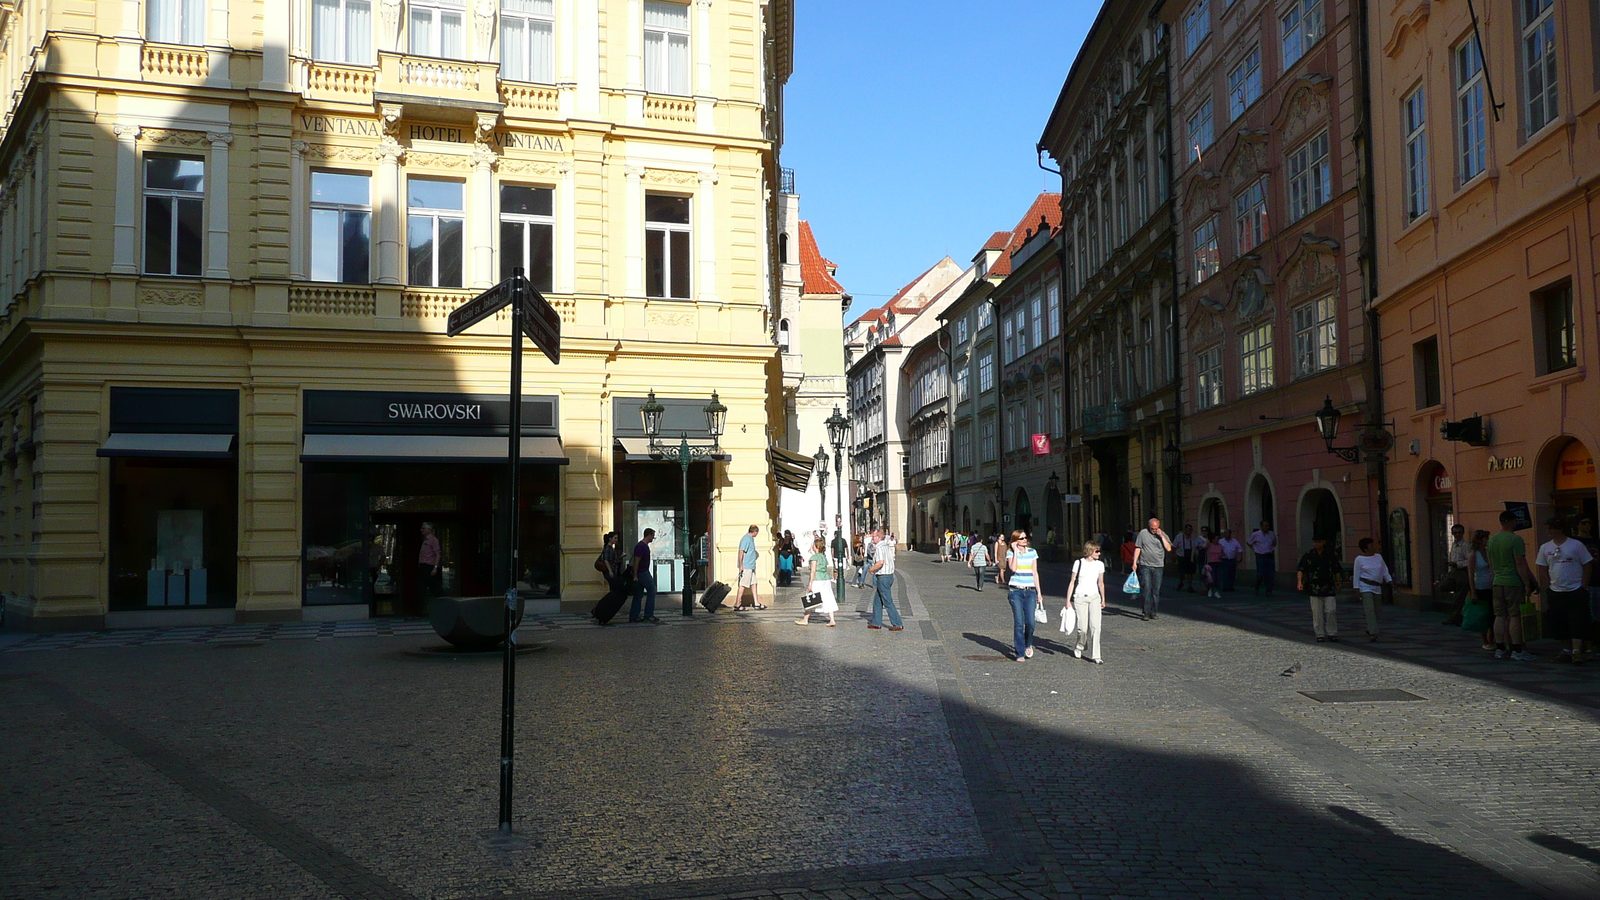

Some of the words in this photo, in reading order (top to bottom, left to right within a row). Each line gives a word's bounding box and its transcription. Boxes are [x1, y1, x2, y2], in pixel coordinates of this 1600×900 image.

[301, 115, 380, 137] VENTANA
[410, 124, 467, 144] HOTEL
[494, 131, 564, 152] VENTANA
[388, 403, 481, 420] SWAROVSKI
[1504, 456, 1523, 470] FOTO
